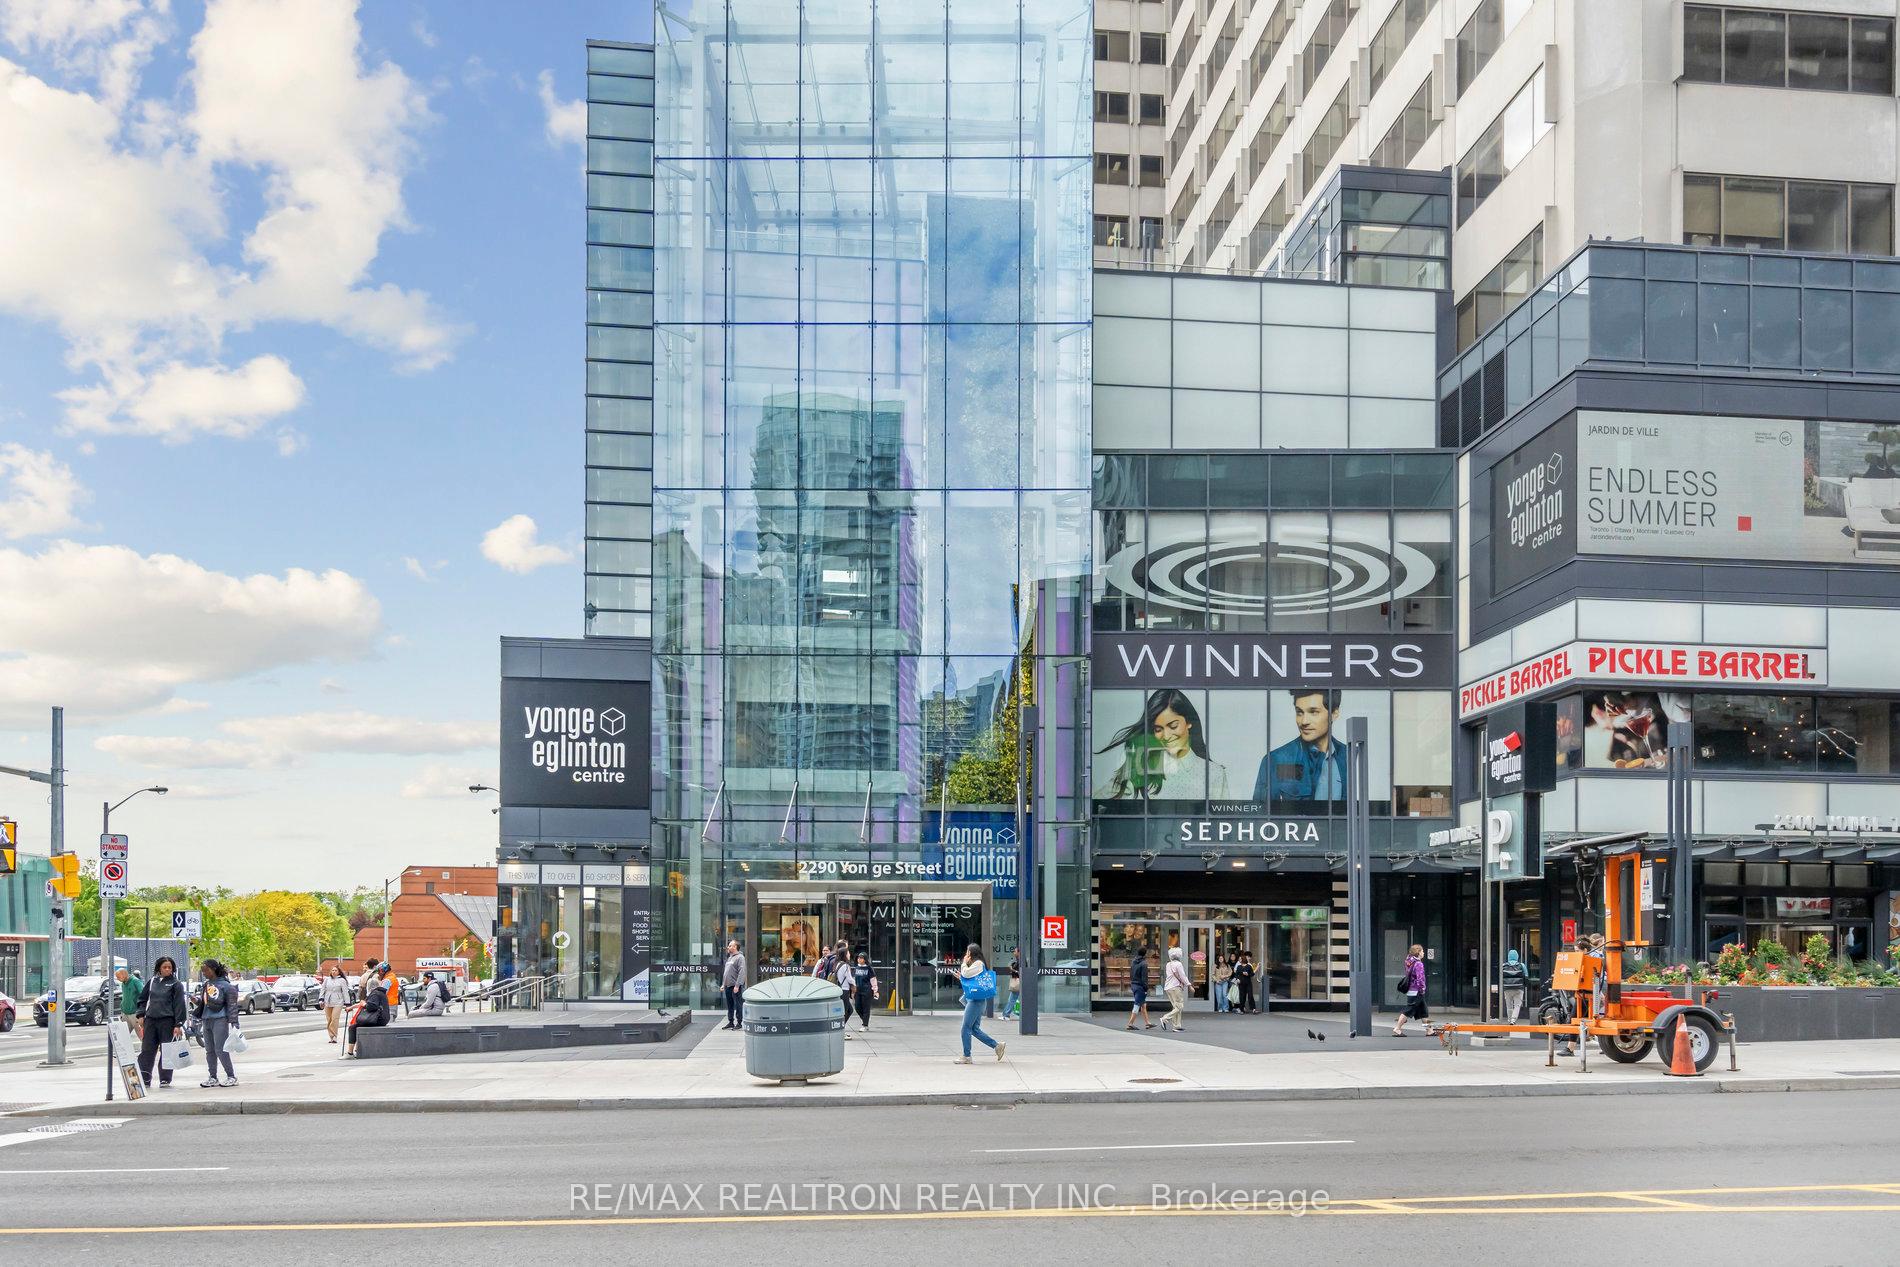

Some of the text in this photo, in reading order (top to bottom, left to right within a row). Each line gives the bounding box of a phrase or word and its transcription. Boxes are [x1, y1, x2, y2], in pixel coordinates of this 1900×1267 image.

[1588, 425, 1659, 437] JARDIN DE VILLE
[1507, 462, 1545, 519] yonge
[1589, 466, 1717, 497] ENDLESS
[1511, 489, 1562, 547] eglinton
[1587, 497, 1716, 527] SUMMER
[1532, 523, 1562, 549] centre
[1117, 643, 1424, 678] WINNERS
[1588, 647, 1816, 682] PICKLE BARREL
[1462, 650, 1572, 713] PICKLE BARREL
[525, 706, 595, 739] yonge
[532, 734, 626, 773] eglinton
[572, 769, 625, 783] centre
[1491, 754, 1521, 780] eglinton
[1503, 773, 1521, 784] centre
[1180, 821, 1320, 842] SEPHORA
[508, 871, 523, 880] THIS
[523, 872, 538, 881] WAY
[547, 872, 556, 880] TO
[558, 872, 576, 880] OVER
[585, 873, 595, 881] 60
[597, 873, 621, 881] SHOPS
[799, 860, 837, 874] 2290
[839, 860, 868, 874] Yon
[895, 860, 942, 875] Street
[945, 846, 1017, 880] eglinton
[663, 965, 709, 973] WINNERS
[759, 966, 805, 974] WINNERS
[754, 1024, 768, 1033] Litter
